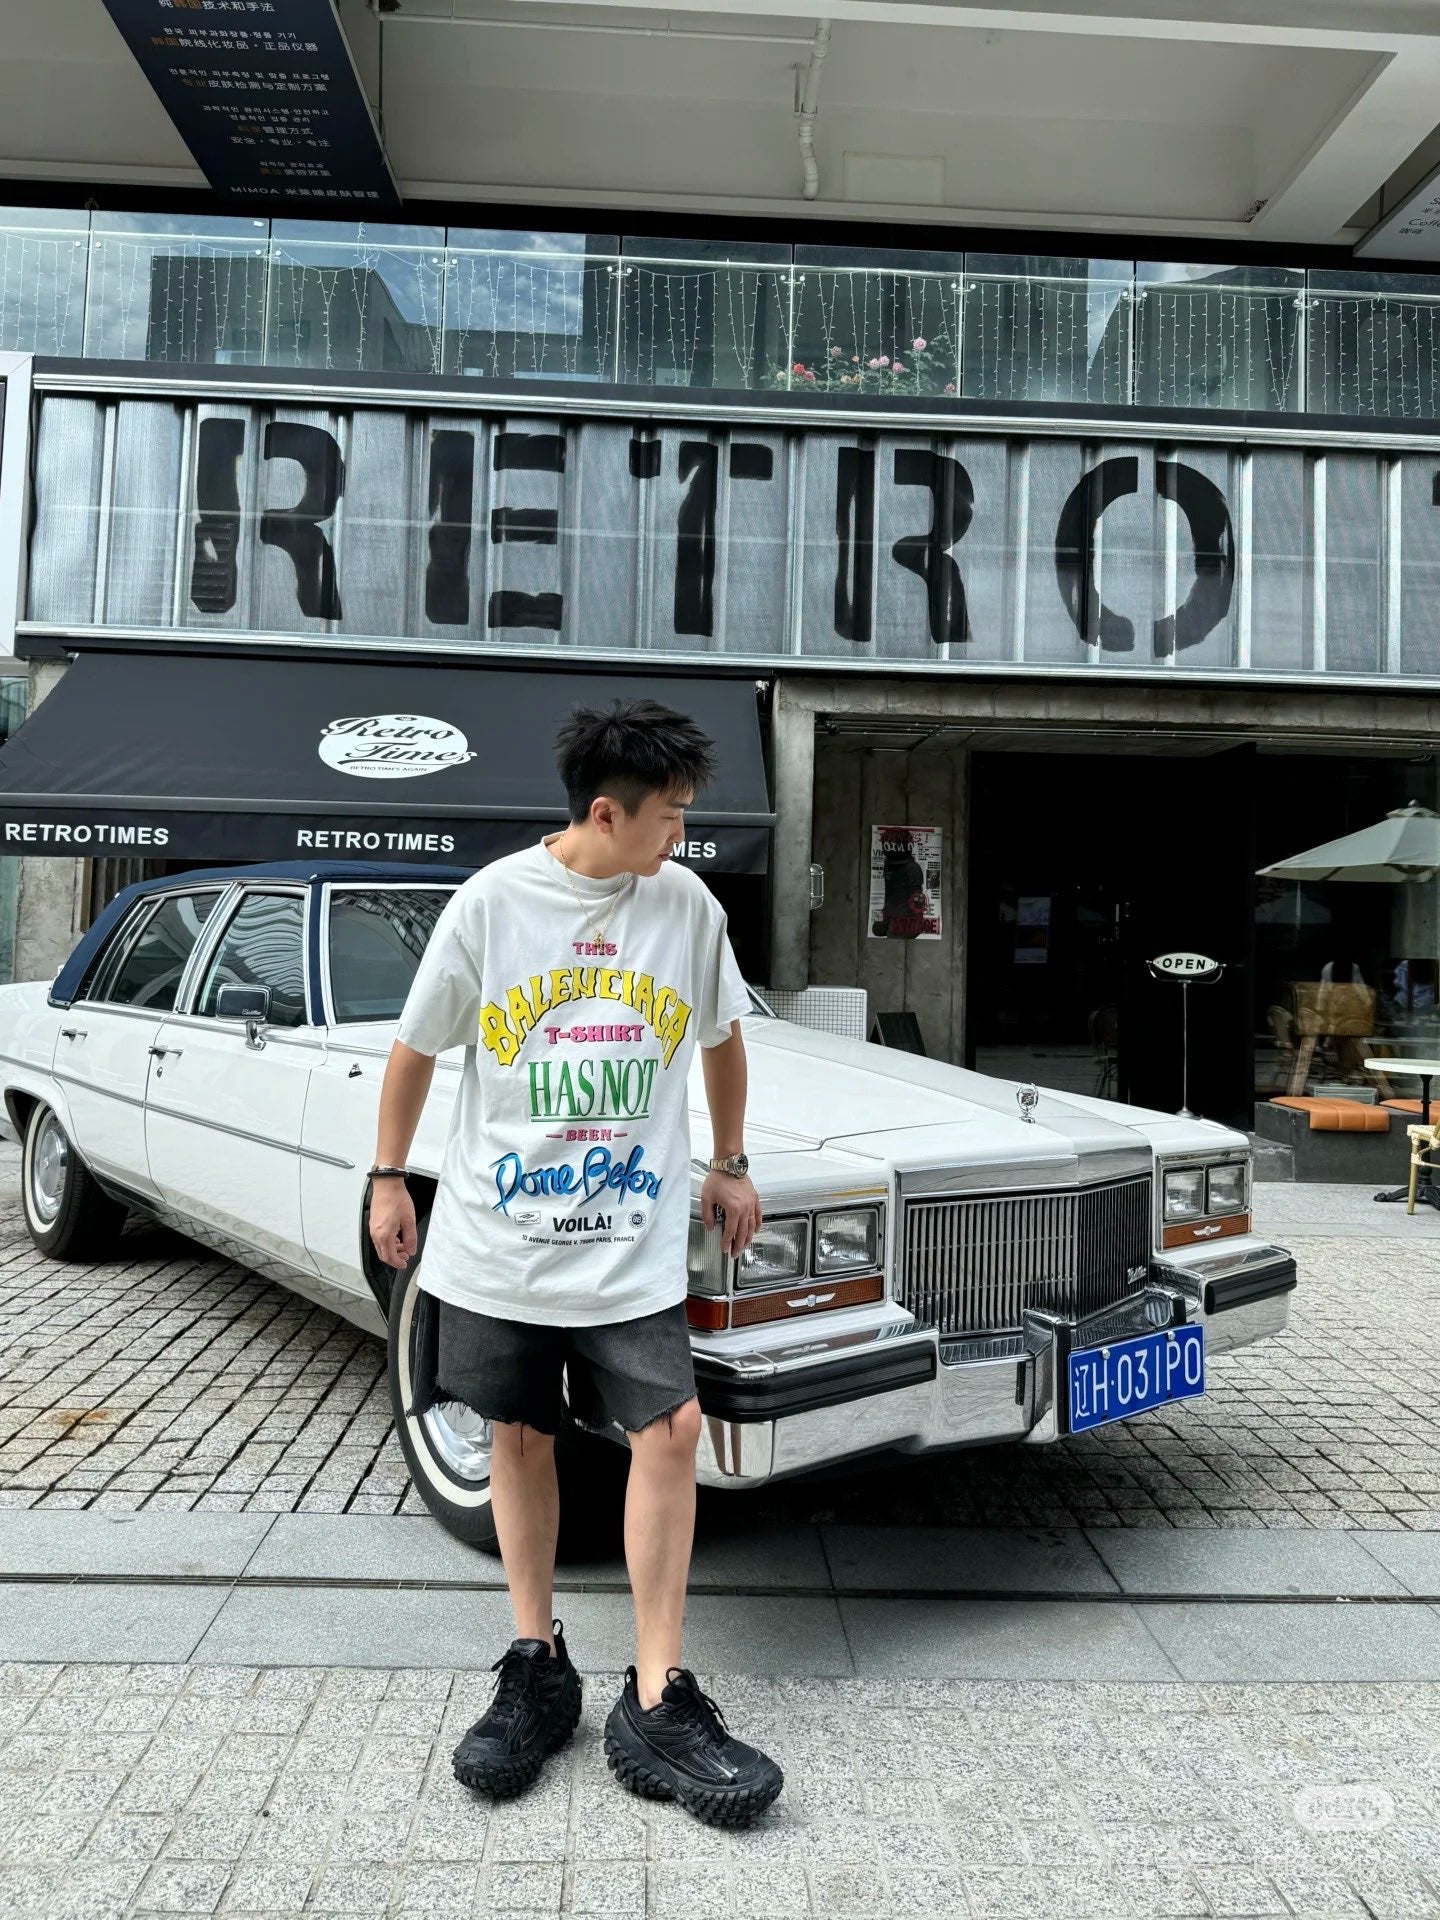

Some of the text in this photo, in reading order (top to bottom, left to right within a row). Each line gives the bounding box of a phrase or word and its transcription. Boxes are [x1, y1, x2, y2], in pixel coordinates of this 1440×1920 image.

[191, 417, 1236, 658] RETRO
[321, 718, 455, 740] Retro
[345, 741, 477, 763] Times
[669, 841, 717, 859] MES
[572, 941, 618, 956] THIS
[1162, 958, 1206, 970] OPEN
[479, 966, 693, 1070] BALENCIAGA
[544, 1024, 645, 1044] T-SHIRT
[528, 1058, 658, 1117] HAS NOT
[565, 1129, 612, 1142] BEEN
[488, 1144, 663, 1218] Done Befor
[552, 1212, 613, 1232] VOILÀ!
[528, 1236, 550, 1245] AVENUE
